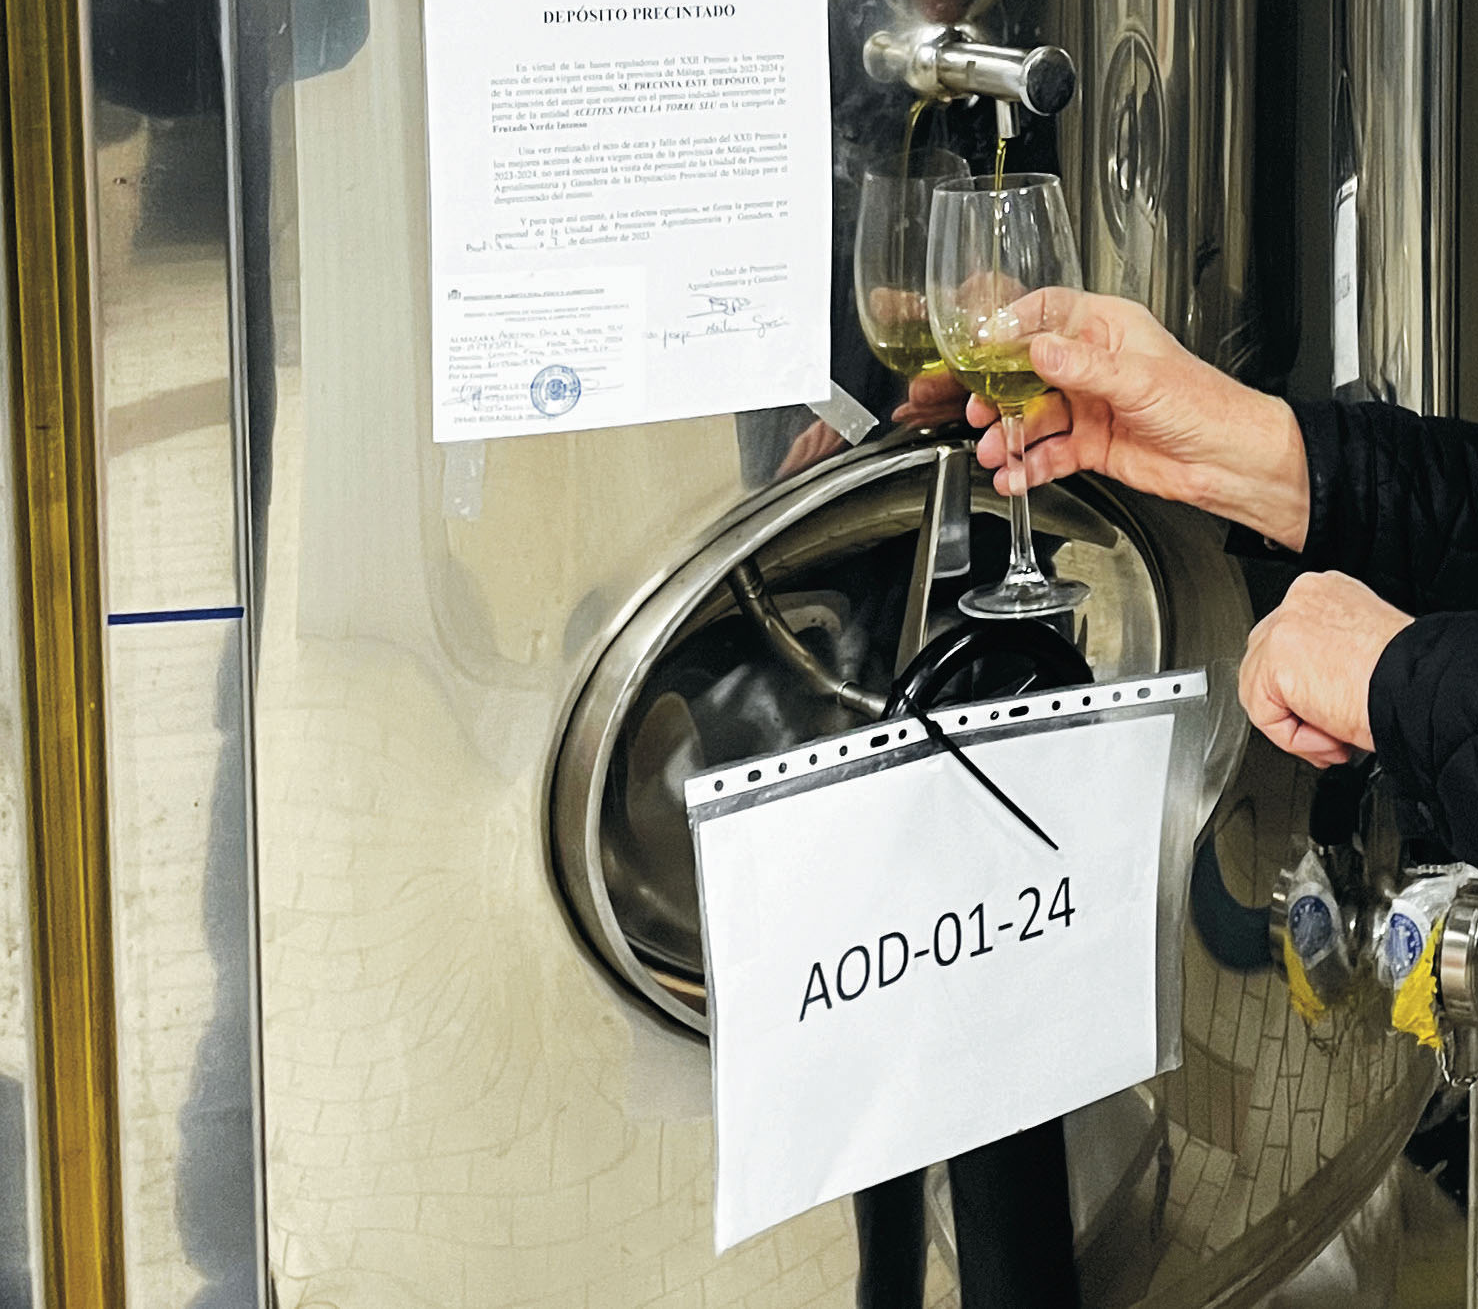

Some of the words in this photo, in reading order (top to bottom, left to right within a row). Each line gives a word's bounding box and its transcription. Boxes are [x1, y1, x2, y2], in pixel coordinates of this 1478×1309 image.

[544, 5, 627, 24] DEPÓSITO
[633, 4, 735, 21] PRECINTADO
[521, 76, 530, 84] de
[665, 69, 673, 77] de
[505, 89, 512, 97] la
[516, 112, 526, 120] de
[493, 124, 527, 133] Frutado
[799, 877, 1075, 1022] AOD-01-24
